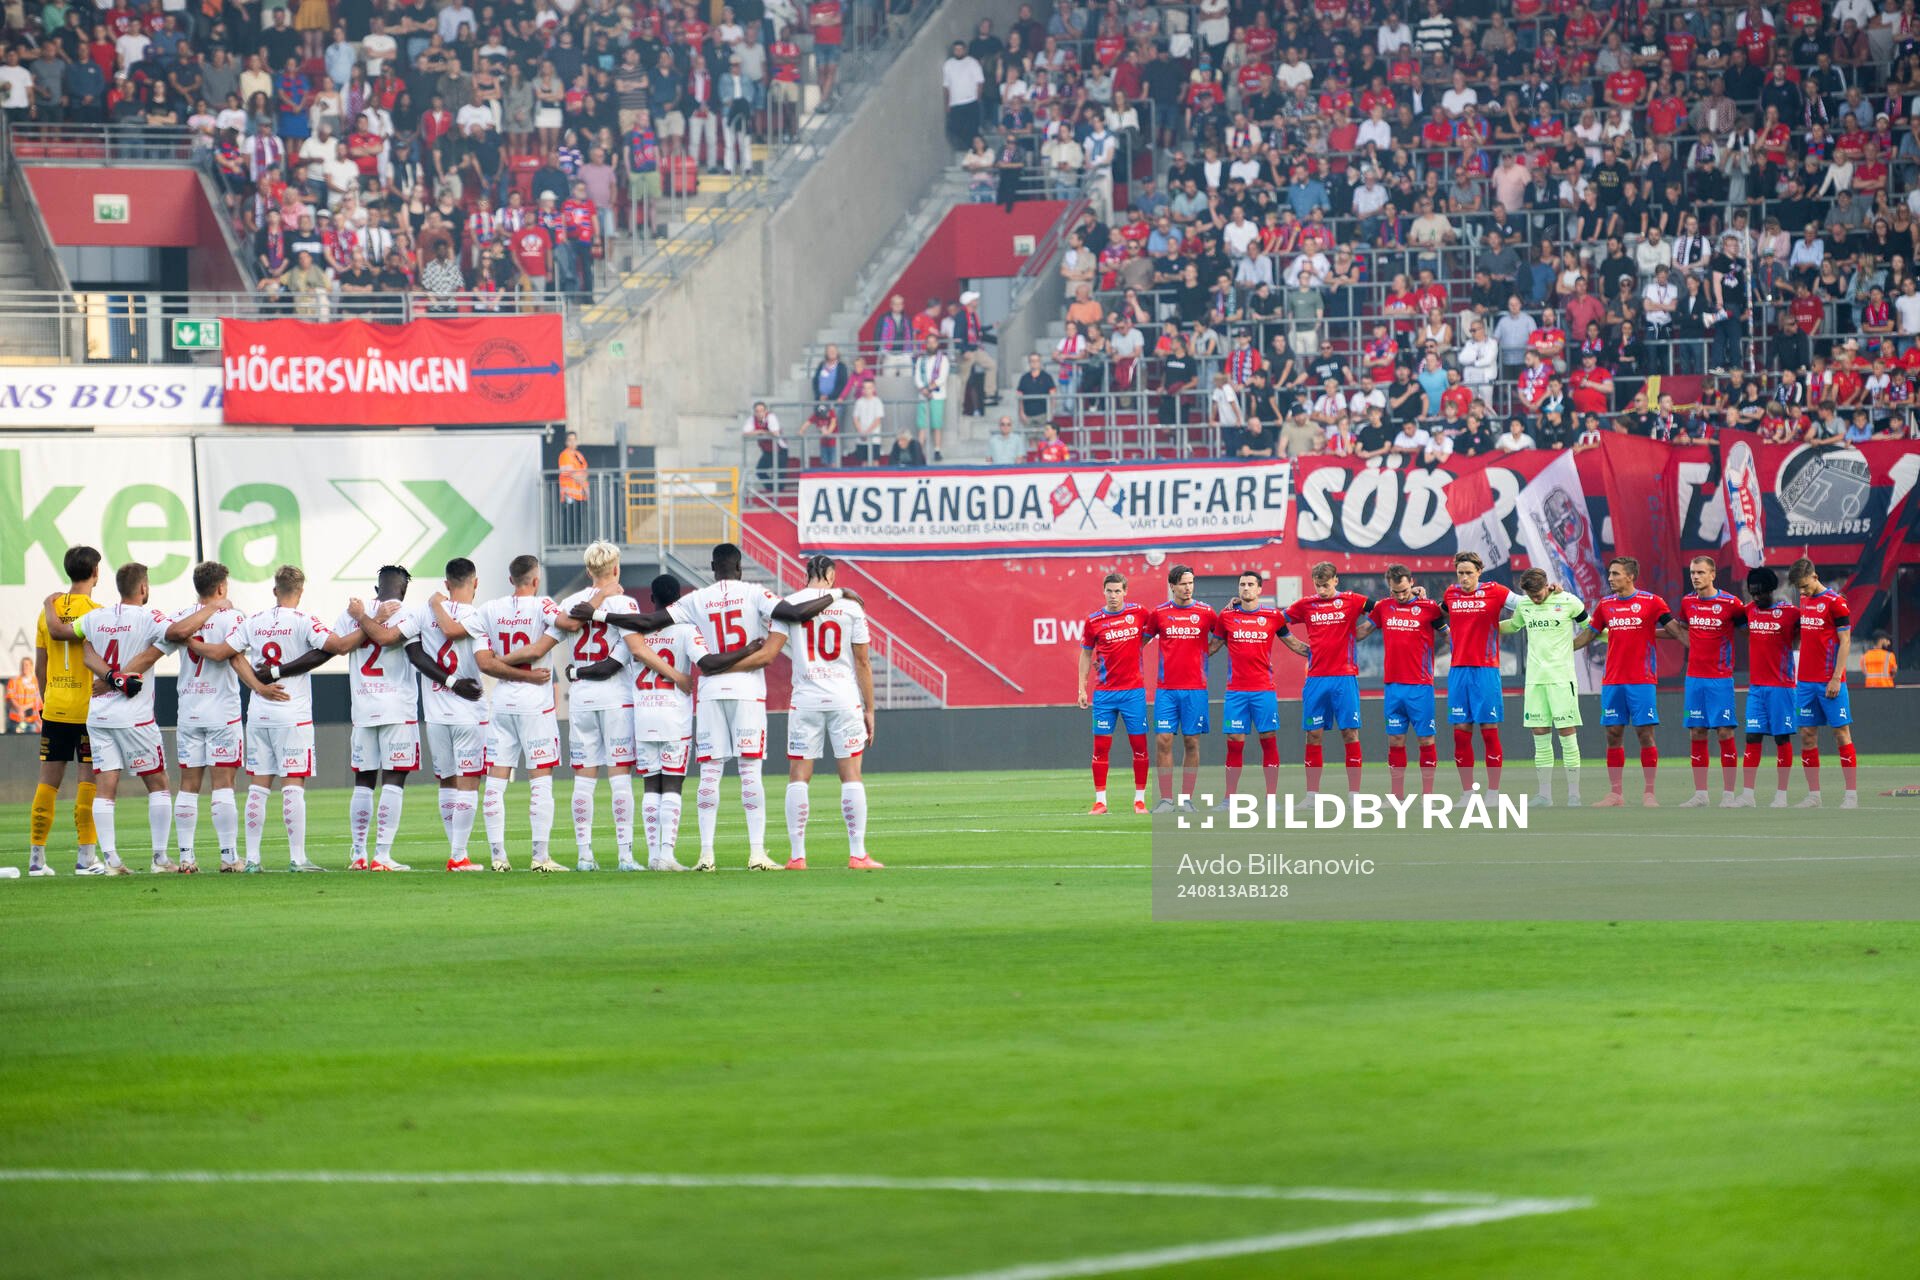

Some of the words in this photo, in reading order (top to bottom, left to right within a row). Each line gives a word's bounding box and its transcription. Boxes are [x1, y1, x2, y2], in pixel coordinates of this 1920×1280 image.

[225, 345, 468, 394] HÖGERSVÄNGEN
[69, 384, 186, 409] BUSS
[810, 479, 1043, 523] AVSTÄNGDA
[1130, 474, 1284, 516] HIF:ARE
[806, 524, 829, 535] FÖR
[929, 525, 981, 535] SJUNGER
[984, 521, 1028, 533] SÅNGER
[1033, 522, 1051, 532] OM
[1129, 517, 1157, 530] VÅRT
[1162, 517, 1183, 529] LAG
[1187, 517, 1198, 527] DI
[1451, 598, 1474, 610] akea
[1310, 611, 1335, 623] akea
[1386, 616, 1410, 627] akea
[1528, 618, 1550, 629] akea
[1608, 616, 1631, 627] akea
[1689, 615, 1711, 627] akea
[1749, 619, 1770, 630] akea
[709, 609, 747, 654] 15
[1105, 627, 1130, 641] akea
[1165, 624, 1191, 636] akea
[1233, 628, 1258, 639] akea
[573, 620, 609, 662] 23
[801, 620, 842, 662] 10
[103, 639, 121, 671] 4
[187, 635, 205, 678] 9
[262, 641, 283, 667] 8
[361, 638, 384, 677] 2
[437, 639, 458, 676] 6
[635, 648, 675, 691] 22
